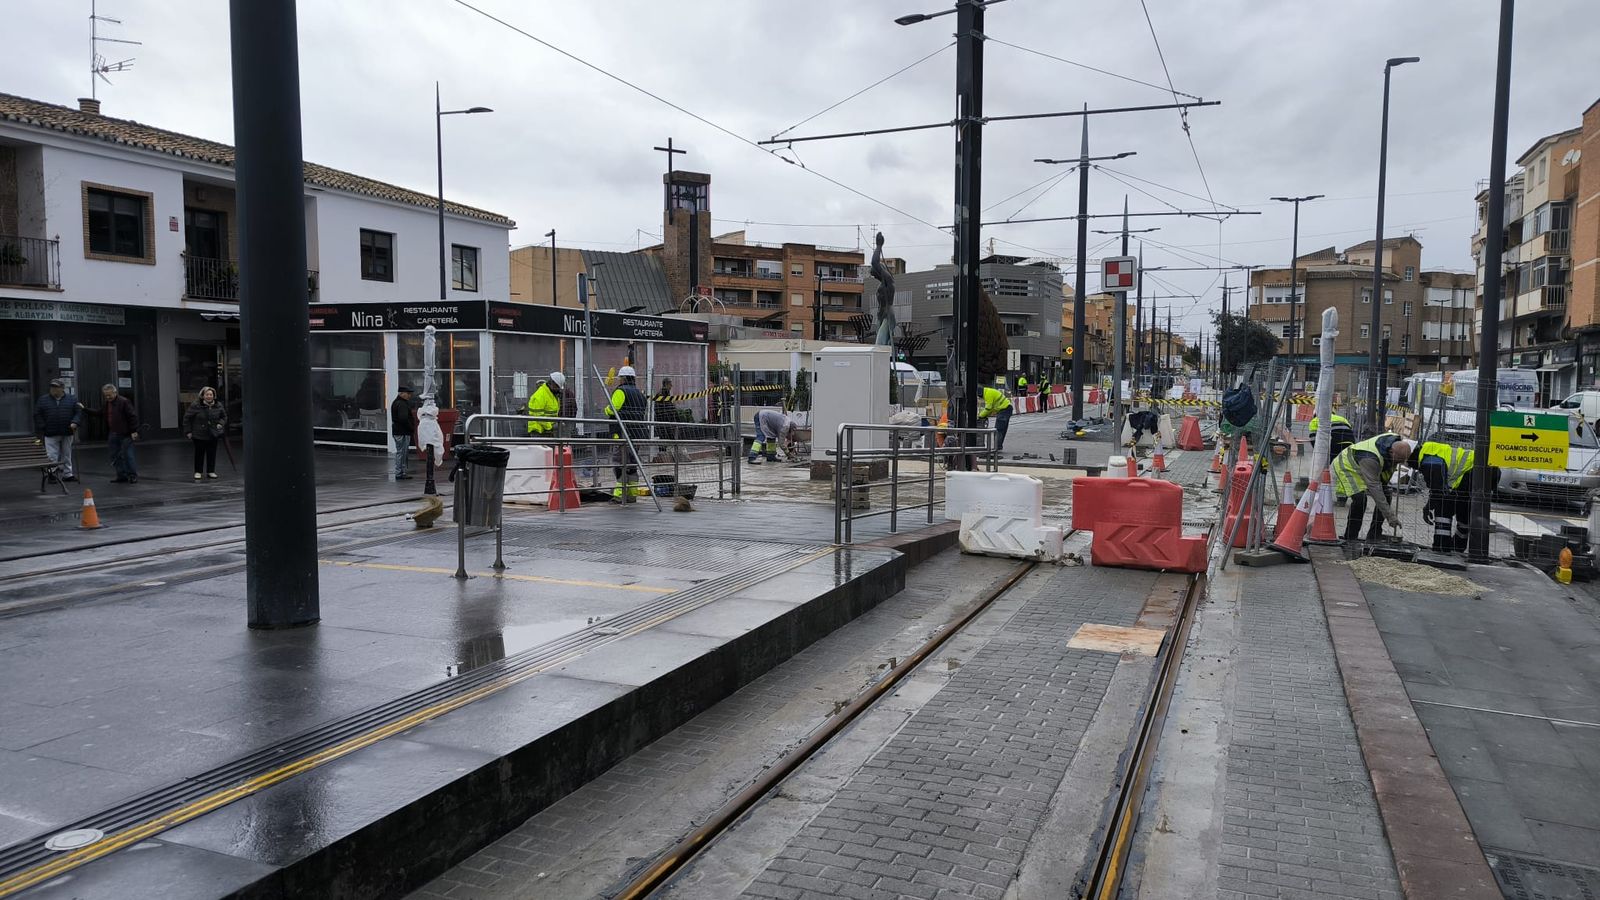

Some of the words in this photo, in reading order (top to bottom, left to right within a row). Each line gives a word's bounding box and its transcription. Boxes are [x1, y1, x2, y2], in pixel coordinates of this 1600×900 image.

[14, 301, 54, 310] POLLOS
[403, 306, 458, 314] RESTAURANTE
[351, 311, 384, 328] Nina
[417, 316, 458, 324] CAFETERÍA
[622, 318, 664, 328] RESTAURANTE
[1495, 443, 1528, 452] ROGAMOS
[1528, 445, 1564, 454] DISCULPEN
[1518, 455, 1553, 464] MOLESTIAS
